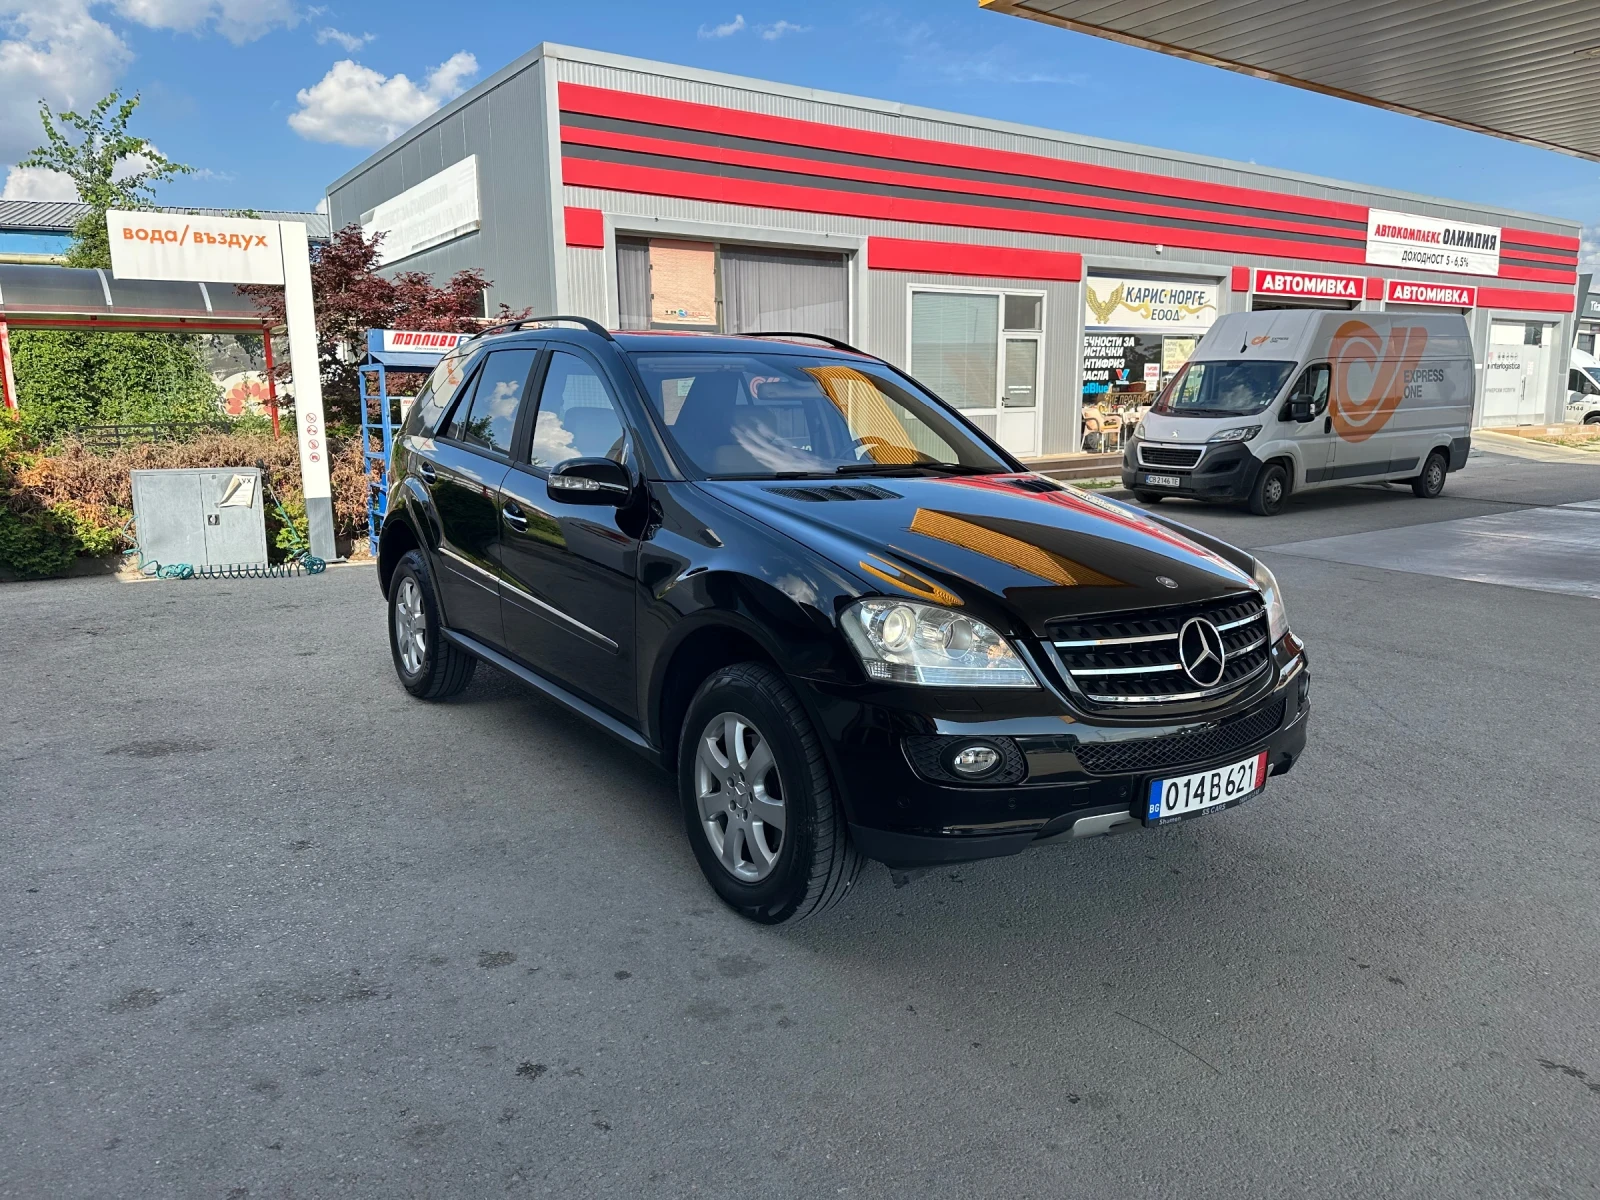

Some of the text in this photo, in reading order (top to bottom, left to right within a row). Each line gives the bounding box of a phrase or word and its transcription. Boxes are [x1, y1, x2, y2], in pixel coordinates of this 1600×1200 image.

[1374, 223, 1497, 251] АВТОКОМПЛЕКС ОЛИМПИЯ
[1401, 250, 1444, 265] ДОХОДНОСТ
[1262, 274, 1357, 296] АВТОМИВКА
[1125, 287, 1206, 306] КАРИС НОРГЕ
[1393, 284, 1469, 304] АВТОМИВКА
[1151, 308, 1180, 321] ЕООД
[1123, 336, 1135, 347] ЗА
[1084, 346, 1124, 357] ИСТАЧКИ
[1082, 358, 1125, 369] НТИФРИЗ
[1403, 369, 1444, 383] EXPRESS
[1403, 385, 1423, 399] ONE
[1149, 803, 1160, 814] BG
[1210, 803, 1226, 814] CARS
